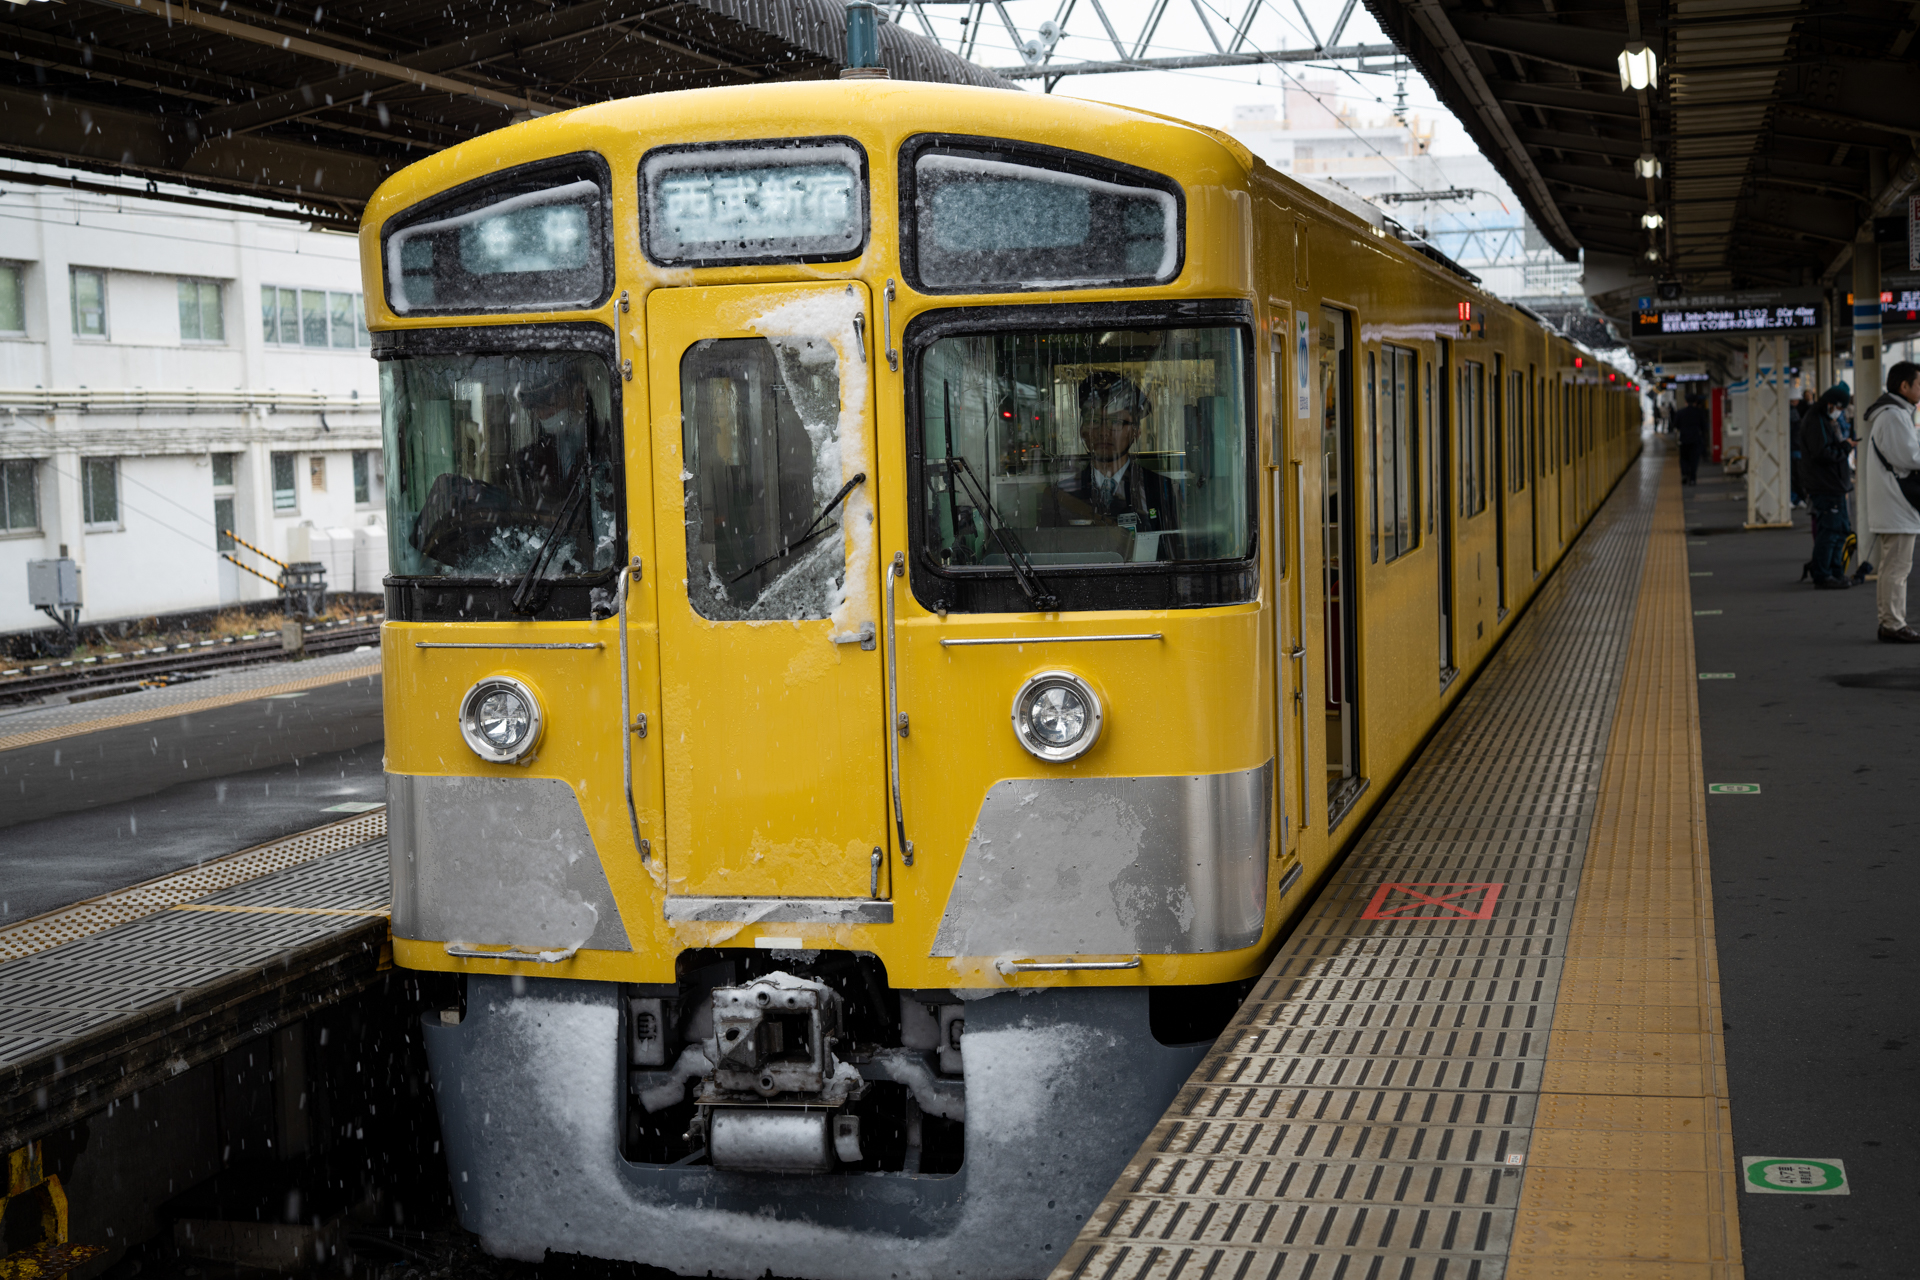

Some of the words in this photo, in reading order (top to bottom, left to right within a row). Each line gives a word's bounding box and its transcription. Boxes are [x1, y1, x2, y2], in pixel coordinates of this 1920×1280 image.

[1639, 313, 1659, 324] 2nd
[1662, 312, 1682, 322] Local
[1738, 308, 1768, 319] 15:02
